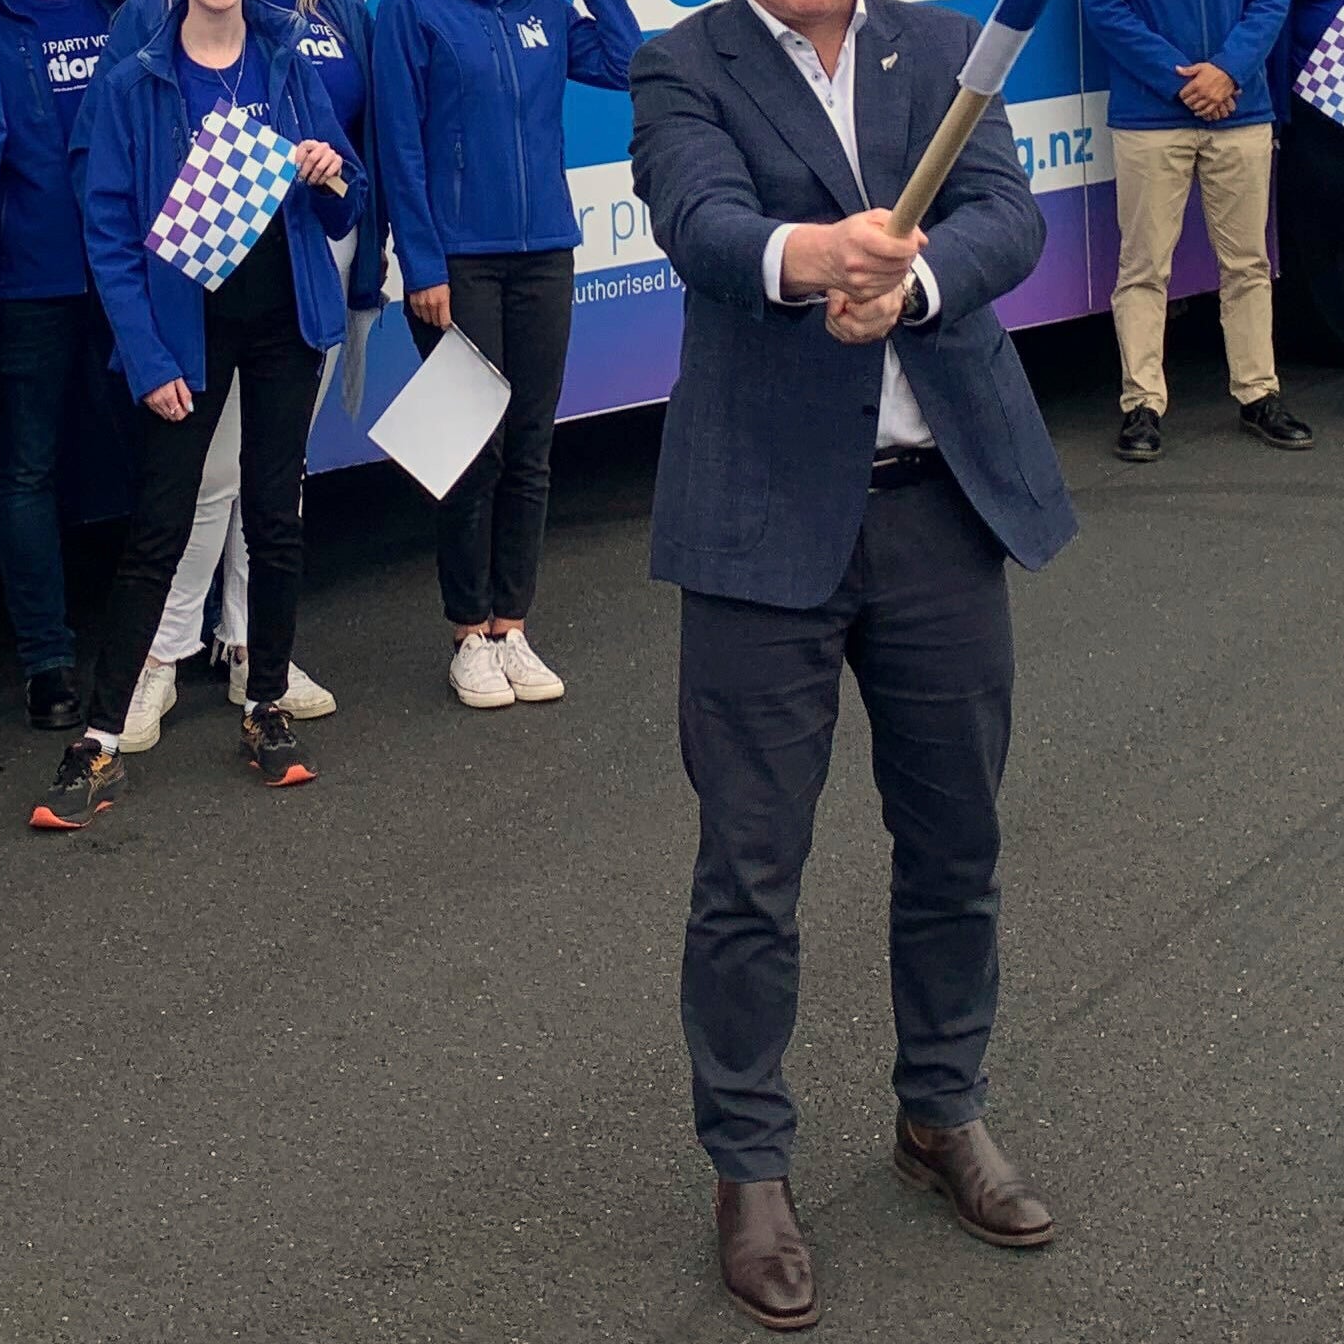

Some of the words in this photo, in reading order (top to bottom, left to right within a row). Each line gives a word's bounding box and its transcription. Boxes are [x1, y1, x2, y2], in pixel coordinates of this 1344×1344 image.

[310, 23, 334, 37] OTE
[48, 36, 89, 54] PARTY
[571, 268, 665, 305] uthorised
[670, 266, 687, 293] b
